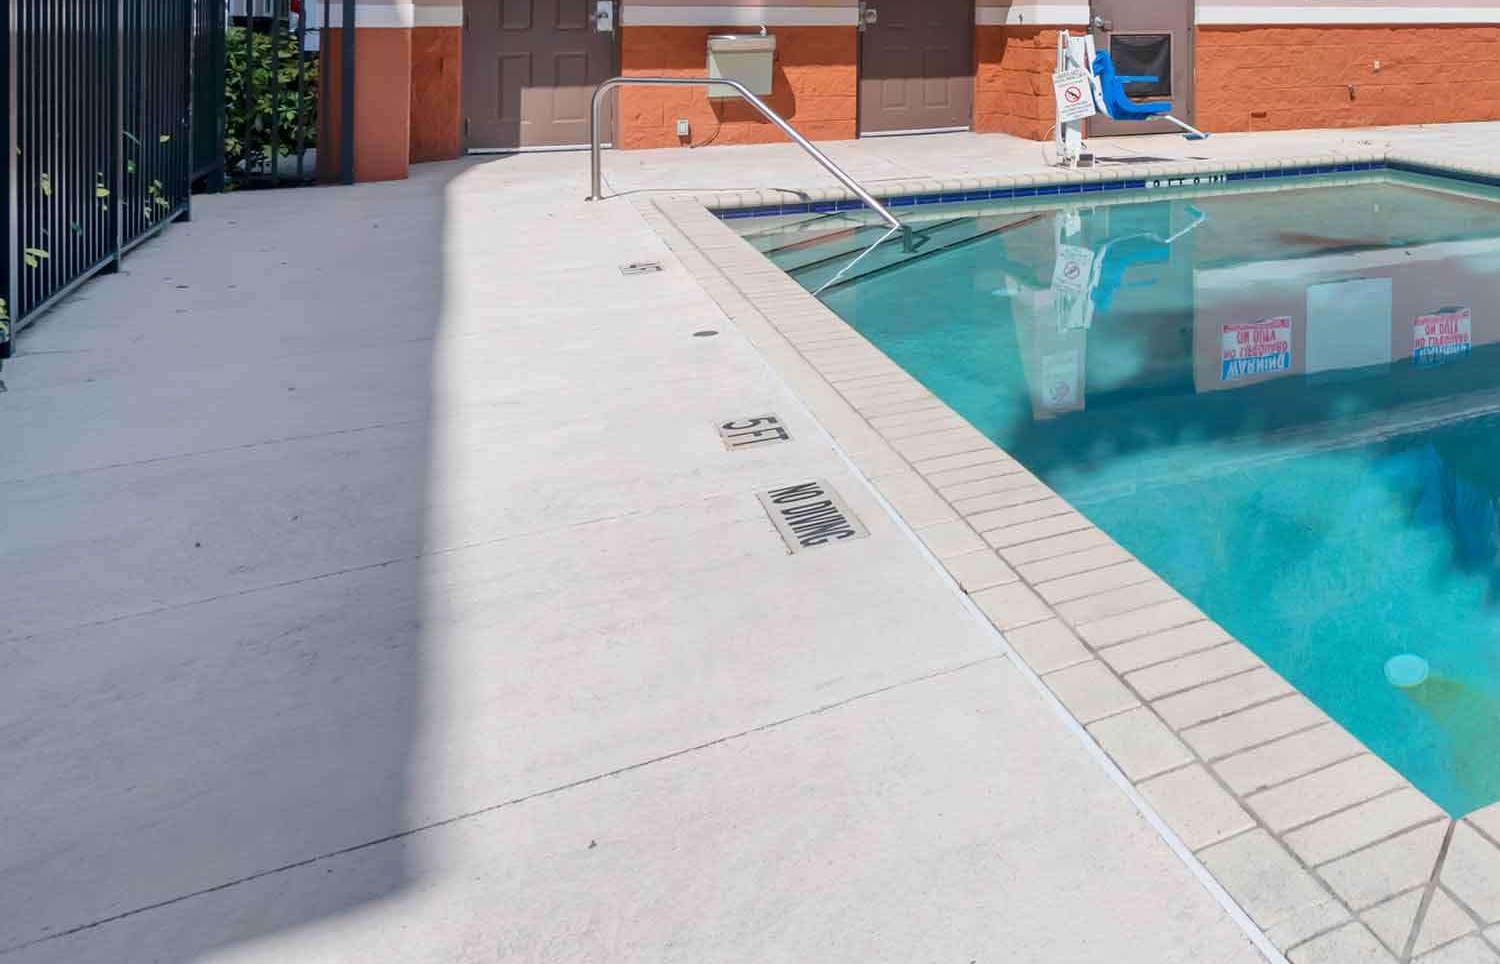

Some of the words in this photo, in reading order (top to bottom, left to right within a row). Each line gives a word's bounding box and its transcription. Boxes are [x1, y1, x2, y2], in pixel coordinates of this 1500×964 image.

[723, 417, 778, 430] 5
[727, 427, 789, 447] FT
[767, 482, 825, 504] NO
[781, 499, 856, 549] DIVING
